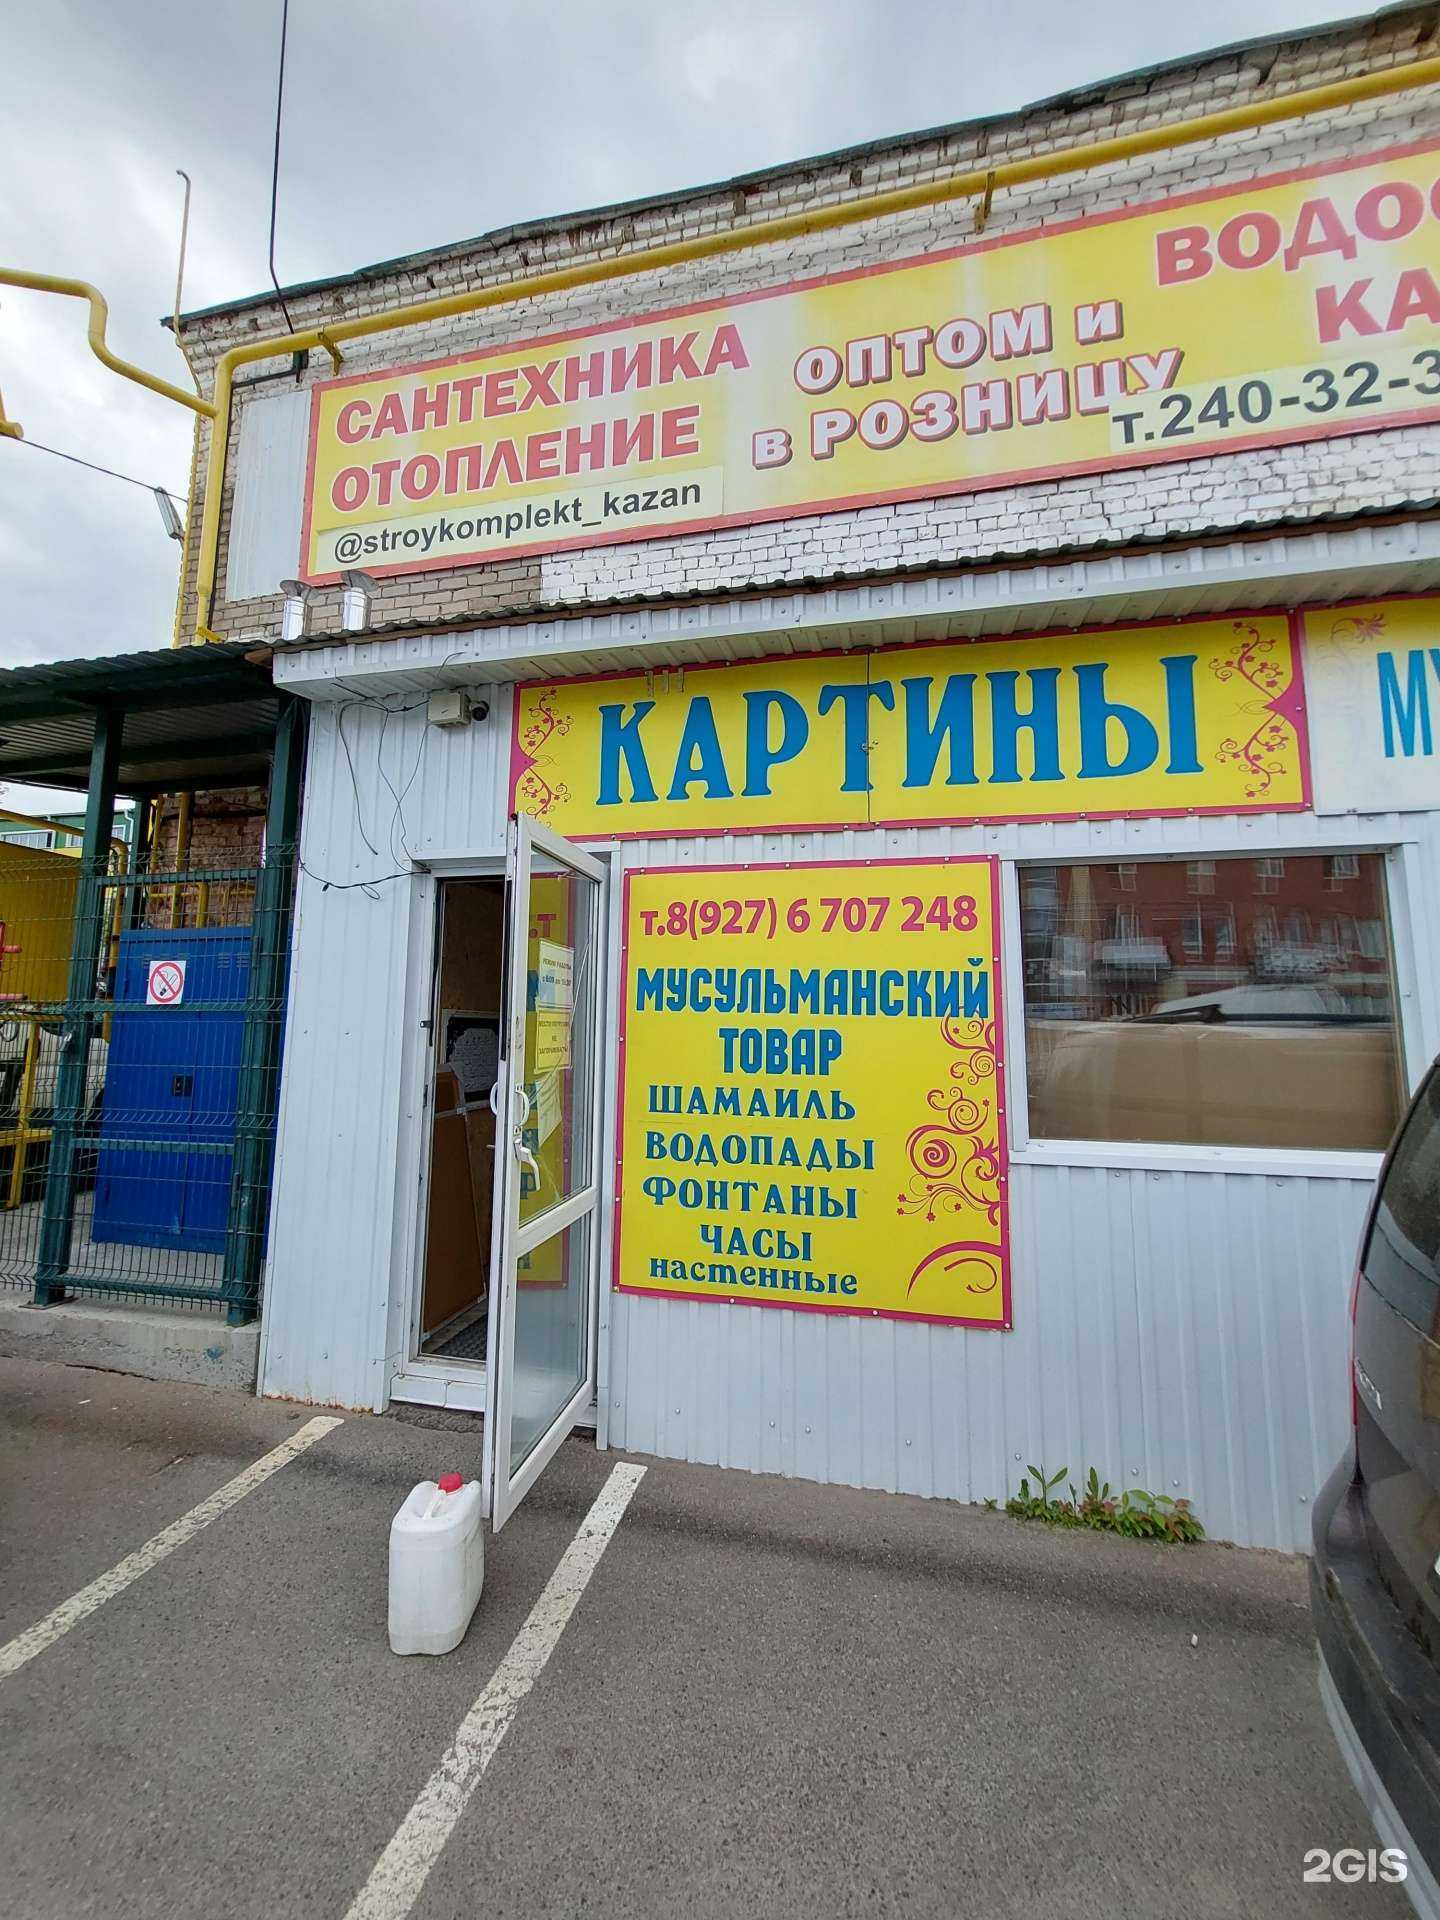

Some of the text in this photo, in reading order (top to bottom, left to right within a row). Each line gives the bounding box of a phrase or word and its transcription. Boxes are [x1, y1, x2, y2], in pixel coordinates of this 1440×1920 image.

[1156, 177, 1440, 286] ВОДО
[1315, 267, 1440, 343] КА
[794, 302, 1052, 394] ОПТОМ
[336, 324, 748, 444] САНТЕХНИКА
[810, 348, 1184, 461] РОЗНИЦУ
[332, 405, 700, 512] ОТОПЛЕНИЕ
[334, 482, 701, 563] @stroykomplekt_kazan
[596, 655, 1204, 806] КАРТИНЫ
[639, 895, 979, 940] т.8(927) 6 707 248
[636, 957, 989, 1018] МУСУЛЬМАНСКИЙ
[719, 1027, 842, 1076] ТОВАР
[648, 1084, 856, 1121] ШАМАИЛЬ
[645, 1130, 875, 1172] ВОДОПАДЫ
[642, 1175, 857, 1219] ФОНТАНЫ
[649, 1257, 858, 1295] настенные
[700, 1223, 812, 1261] ЧАСЫ
